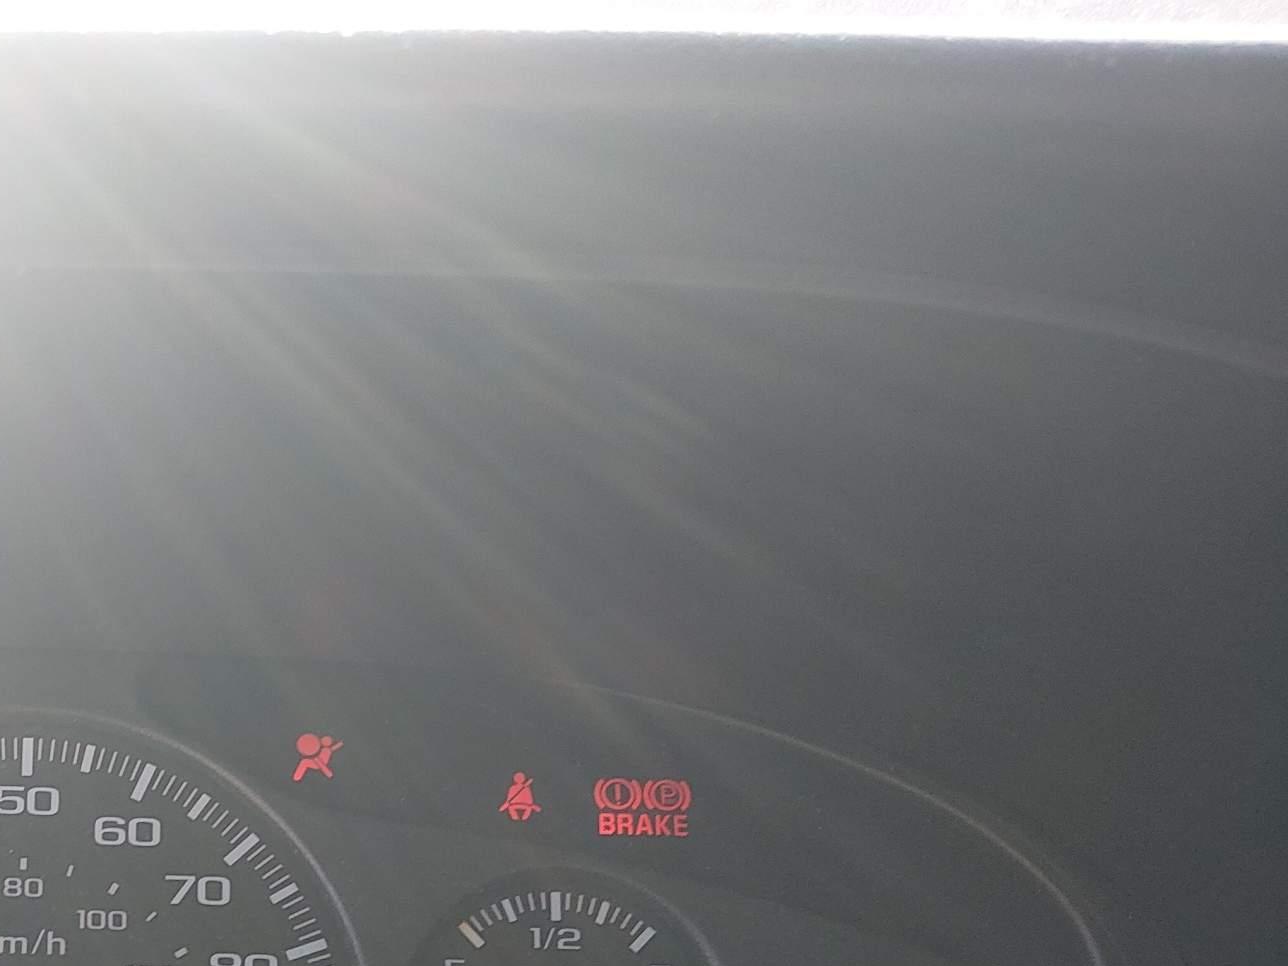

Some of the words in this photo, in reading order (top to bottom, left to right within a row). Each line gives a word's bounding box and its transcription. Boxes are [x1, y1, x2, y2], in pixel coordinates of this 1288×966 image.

[93, 817, 161, 846] 60
[598, 812, 689, 836] BRAKE
[2, 877, 43, 898] 80
[164, 875, 231, 906] 70
[77, 910, 127, 931] 100
[530, 928, 581, 950] 1/2
